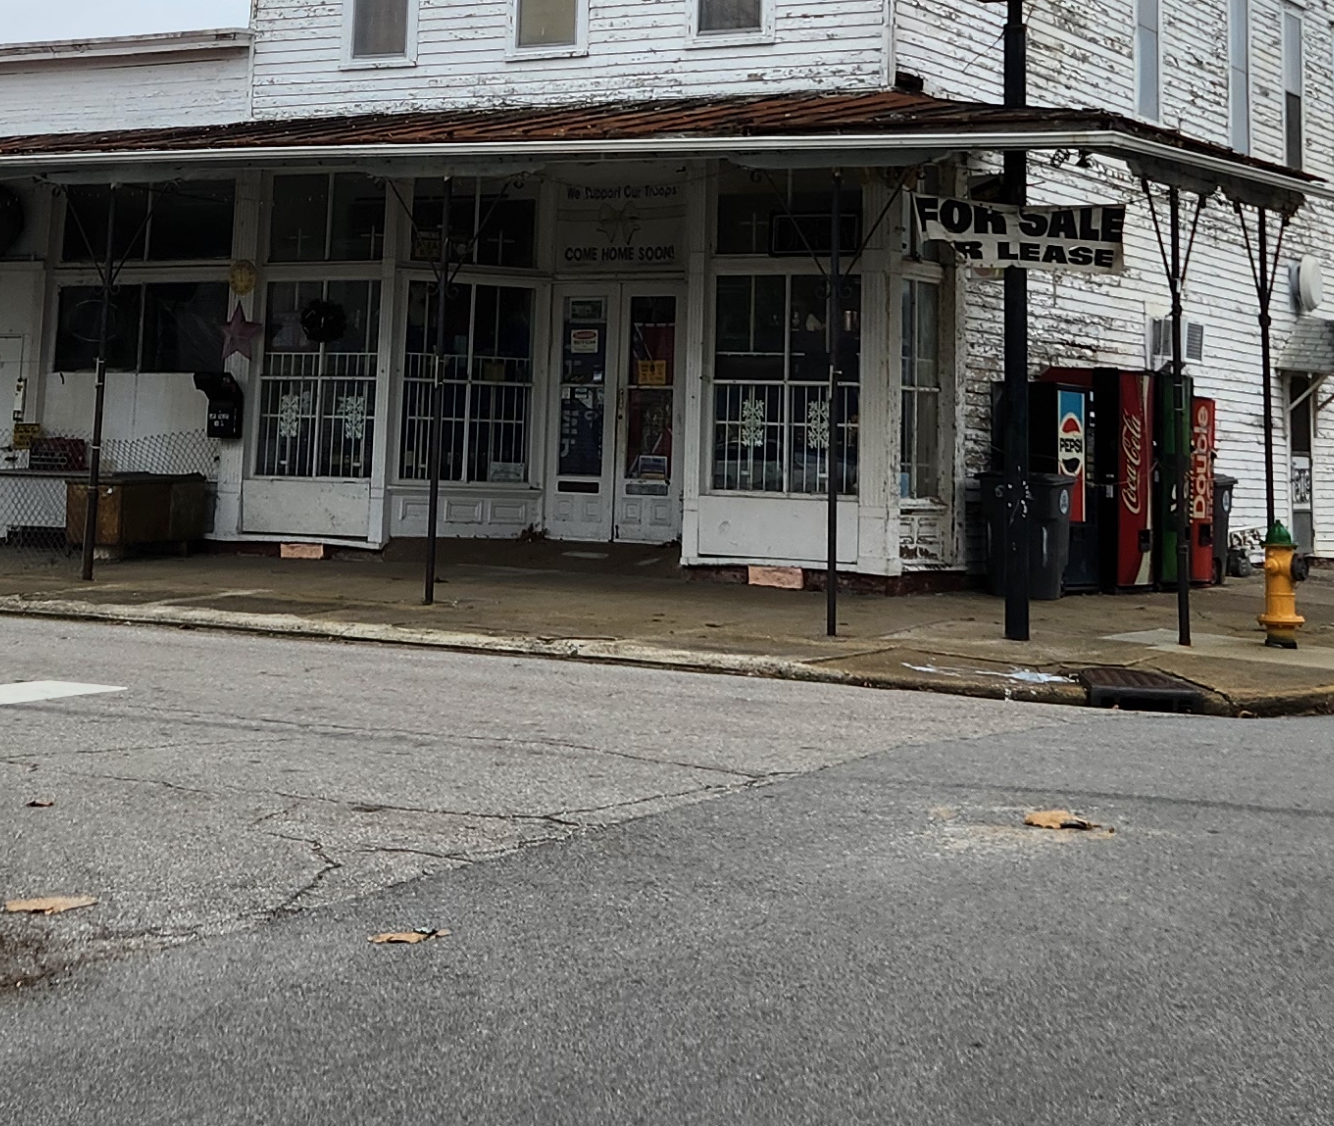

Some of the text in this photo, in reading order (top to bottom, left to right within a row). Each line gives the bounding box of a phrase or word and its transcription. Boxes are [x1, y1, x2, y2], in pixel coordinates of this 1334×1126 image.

[566, 185, 677, 200] We Support Our Troops
[916, 197, 1126, 243] FOR SALE
[564, 245, 675, 262] COME HOME SOON!
[997, 240, 1114, 268] LEASE
[1059, 437, 1083, 454] PEPSI
[1193, 405, 1209, 520] Double
